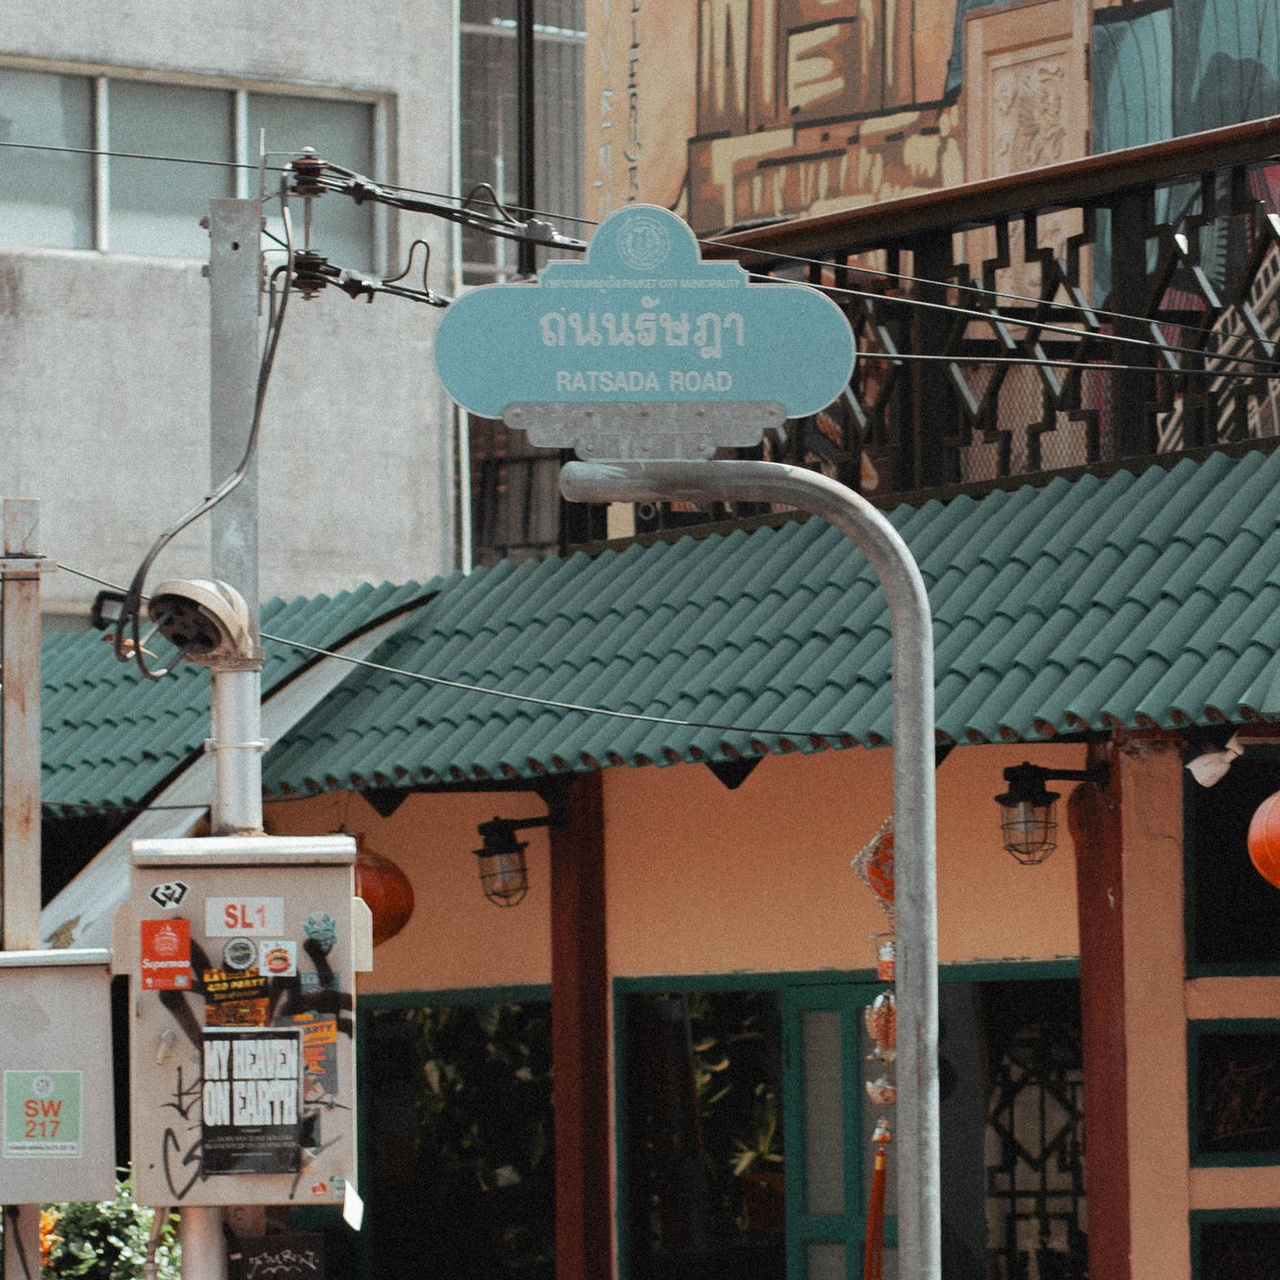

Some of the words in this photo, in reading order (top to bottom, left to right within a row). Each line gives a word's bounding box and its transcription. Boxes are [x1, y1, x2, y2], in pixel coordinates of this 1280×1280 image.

[538, 295, 745, 359] ถนนรัษฎา
[556, 370, 660, 393] RATSADA
[669, 370, 733, 393] ROAD
[203, 1039, 231, 1080] MY
[232, 1039, 298, 1080] HEAVEN
[24, 1099, 63, 1118] SW
[202, 1080, 231, 1127] ON
[232, 1080, 298, 1126] EARTH
[24, 1120, 60, 1138] 217
